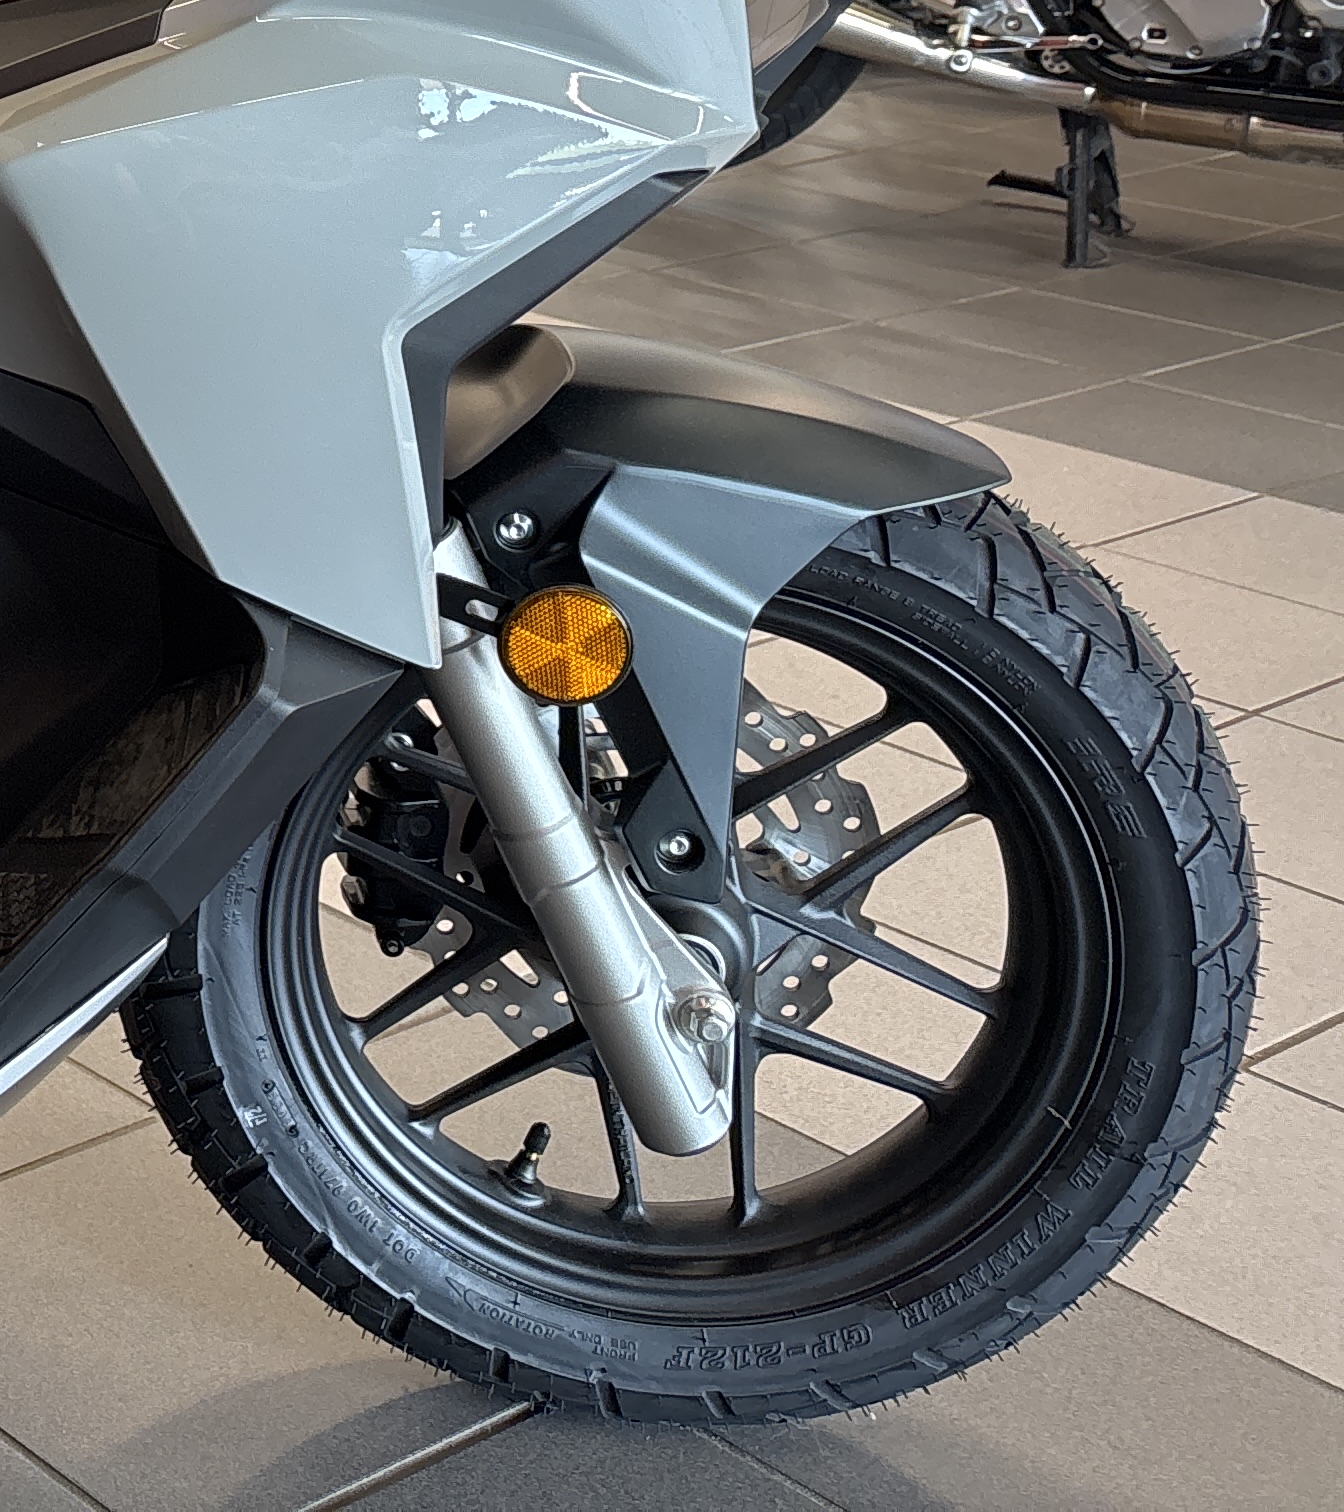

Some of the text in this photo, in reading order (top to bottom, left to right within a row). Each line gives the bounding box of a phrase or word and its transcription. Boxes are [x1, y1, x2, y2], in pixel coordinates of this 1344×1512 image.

[1069, 1057, 1155, 1191] TRAIL
[897, 1201, 1073, 1329] WINNER
[478, 1301, 556, 1340] ROTATION
[591, 1344, 639, 1362] FRONT
[663, 1323, 873, 1371] GP-212F
